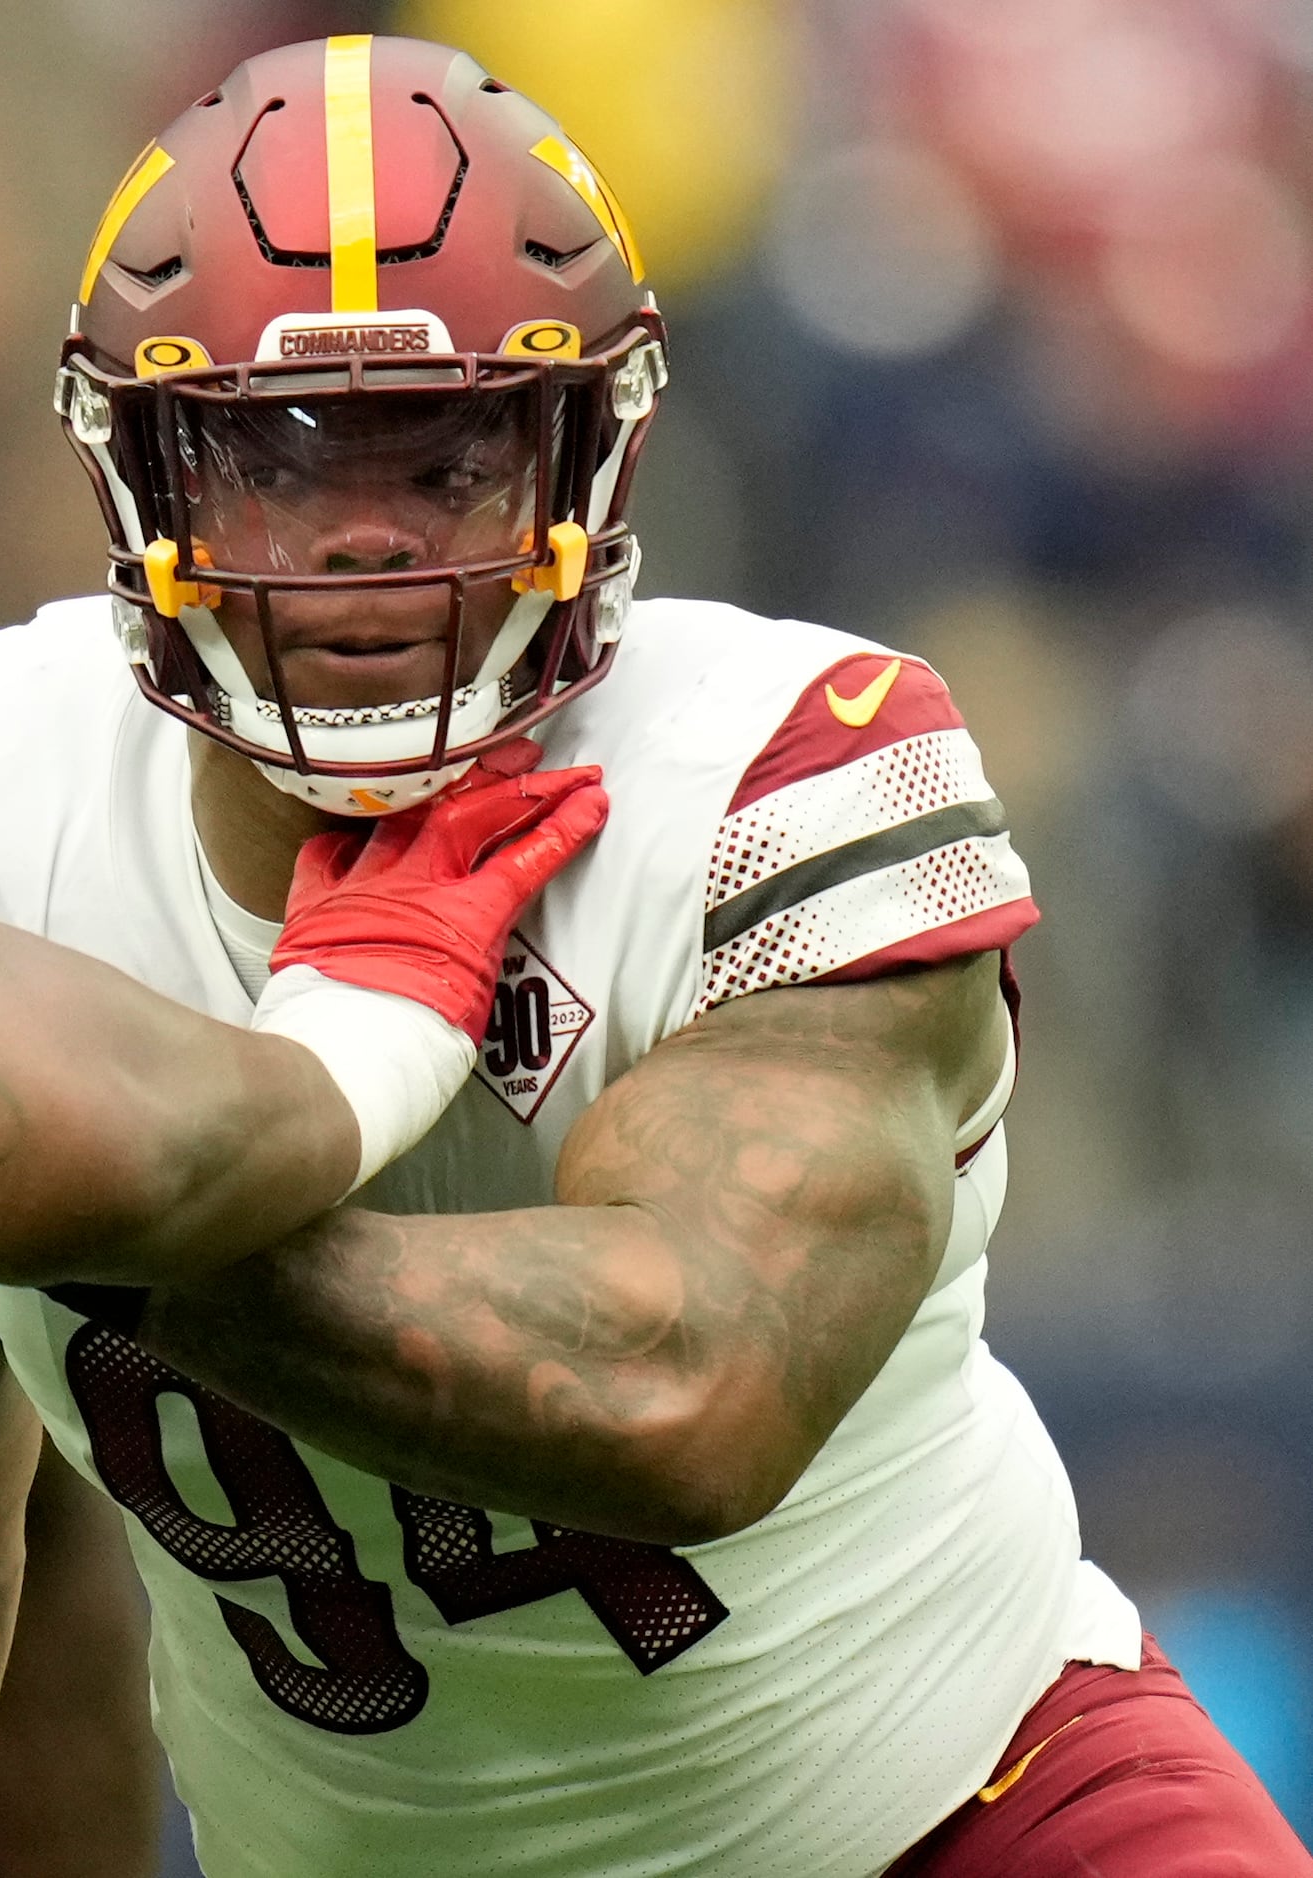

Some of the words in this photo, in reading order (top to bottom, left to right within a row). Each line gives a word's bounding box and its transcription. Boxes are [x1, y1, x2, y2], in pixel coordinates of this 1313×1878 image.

[279, 328, 430, 357] COMMANDERS
[484, 976, 552, 1077] 90
[551, 1010, 585, 1026] 2022
[502, 1077, 539, 1097] YEARS
